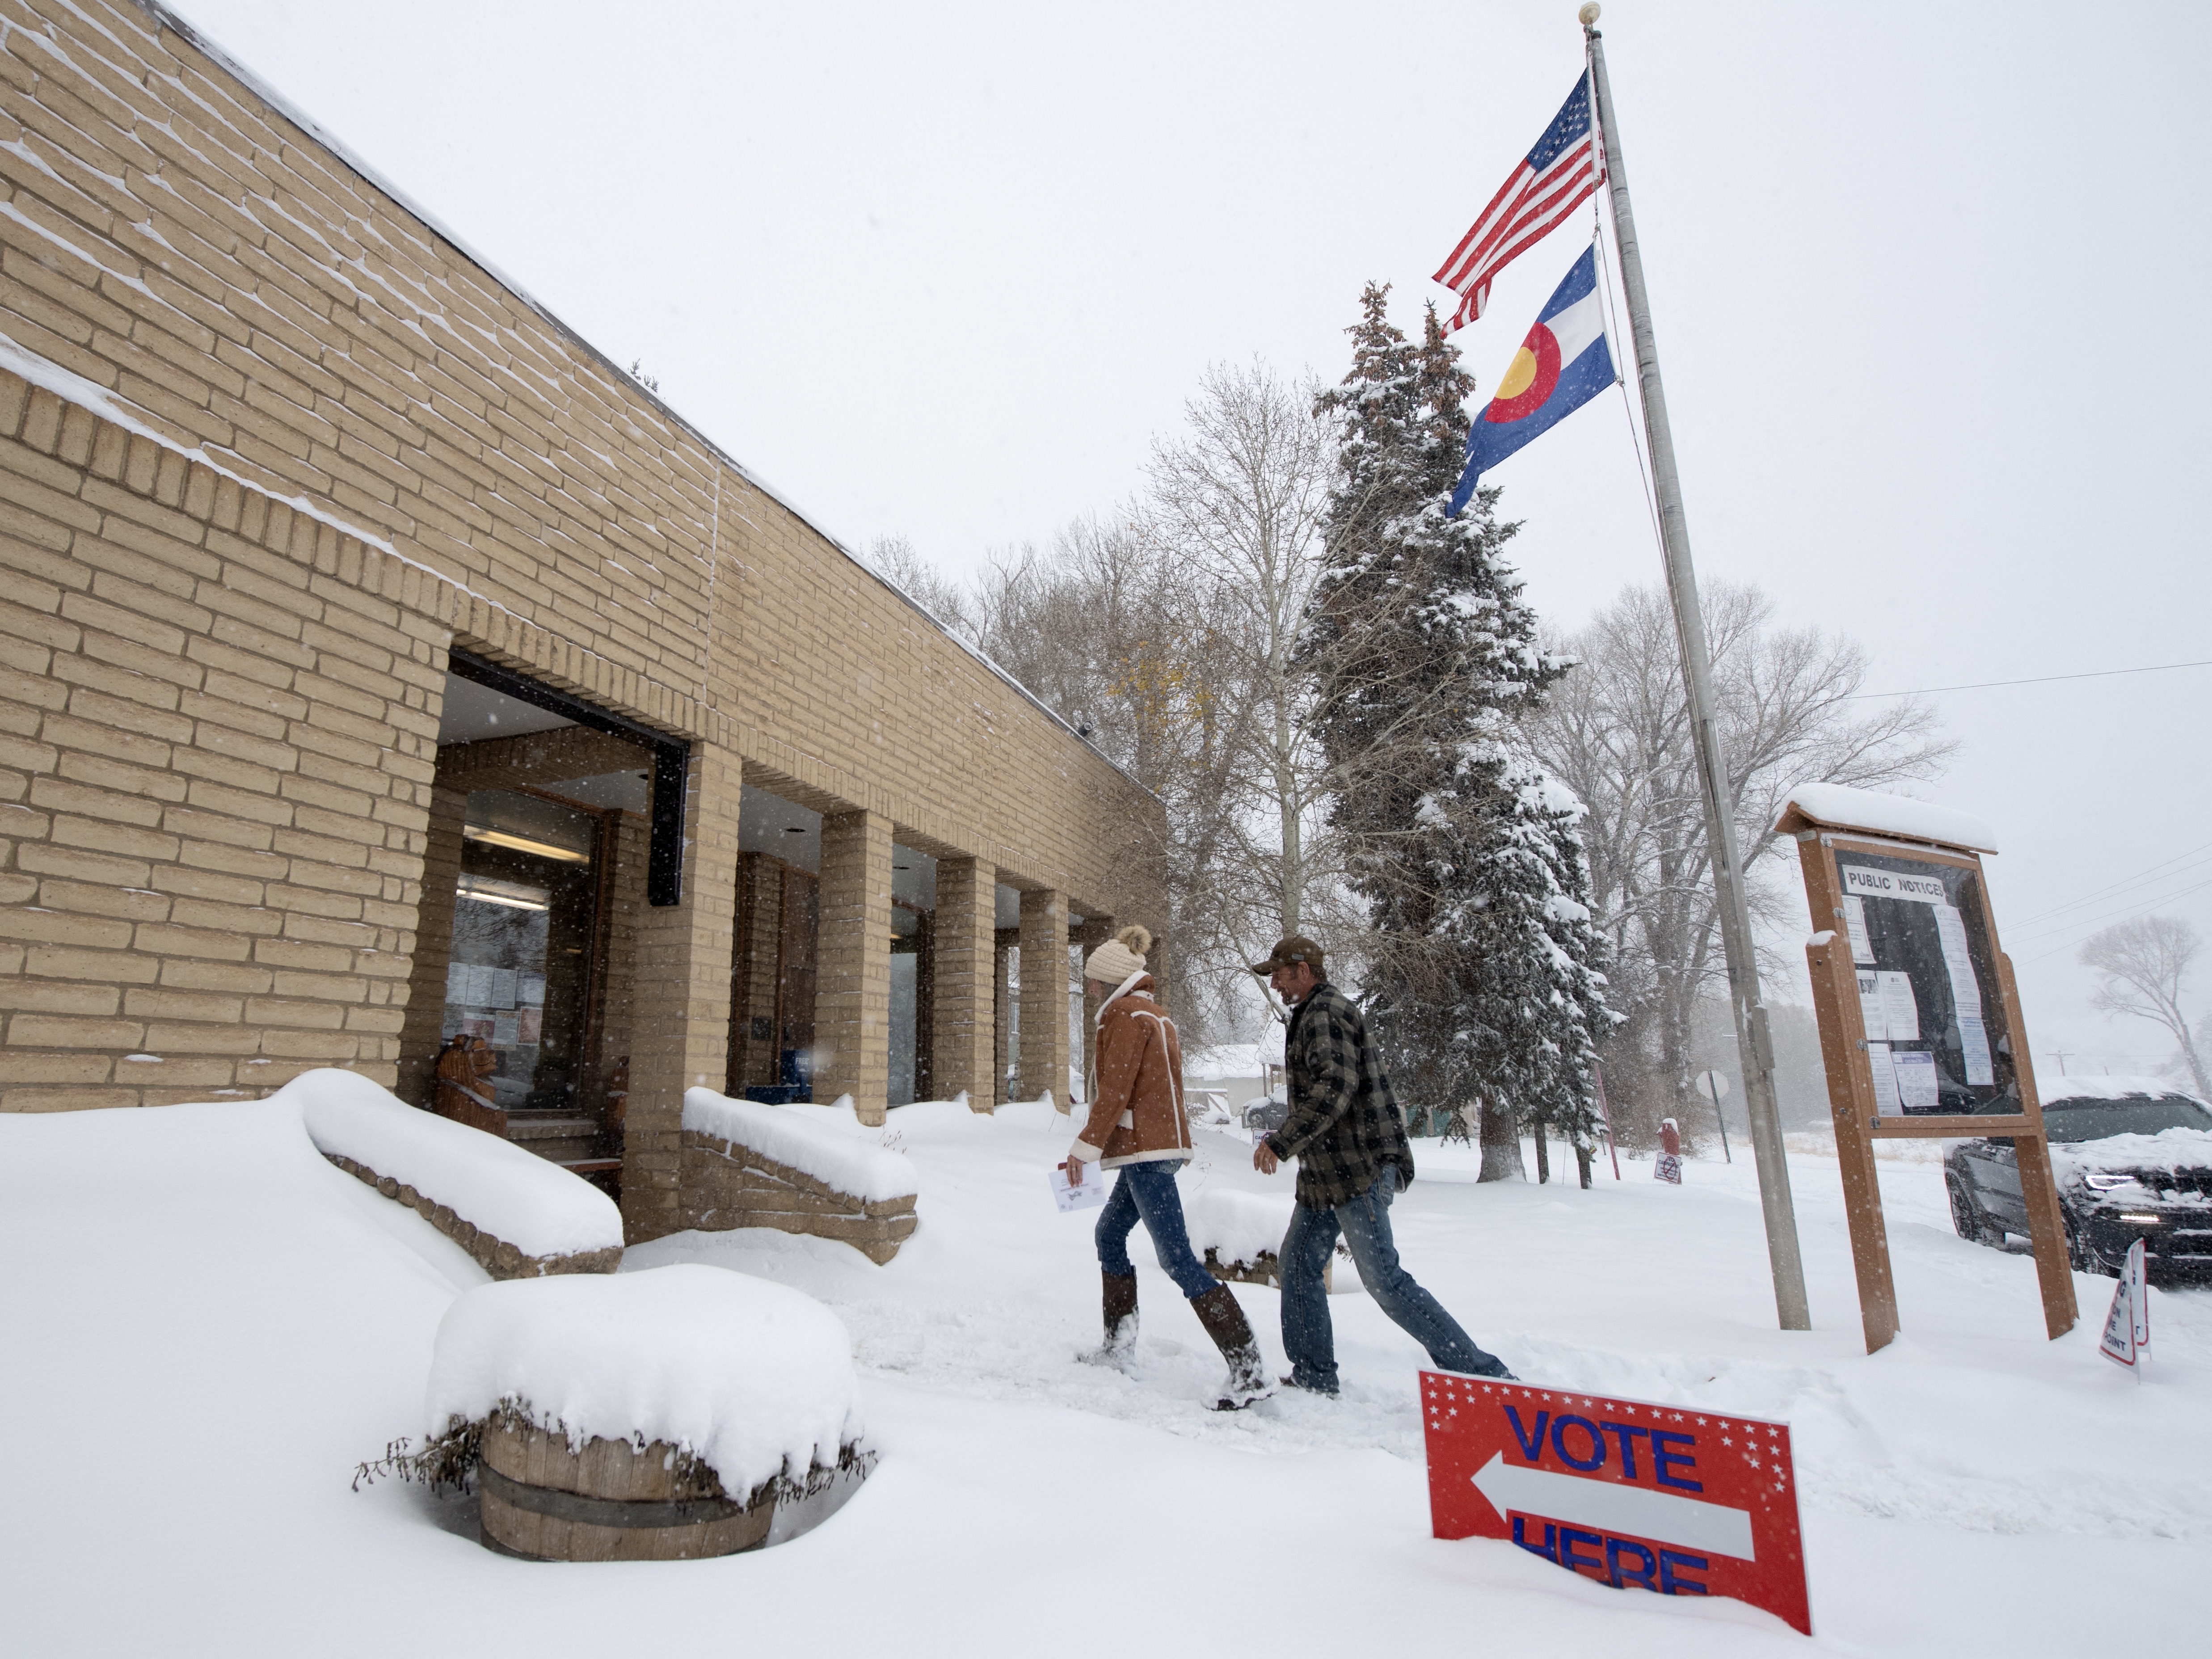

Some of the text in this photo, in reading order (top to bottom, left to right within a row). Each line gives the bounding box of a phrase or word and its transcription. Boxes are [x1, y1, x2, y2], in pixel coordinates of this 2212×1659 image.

[1848, 872, 1944, 897] PUBLIC NOTICES
[1502, 1404, 1703, 1493] VOTE
